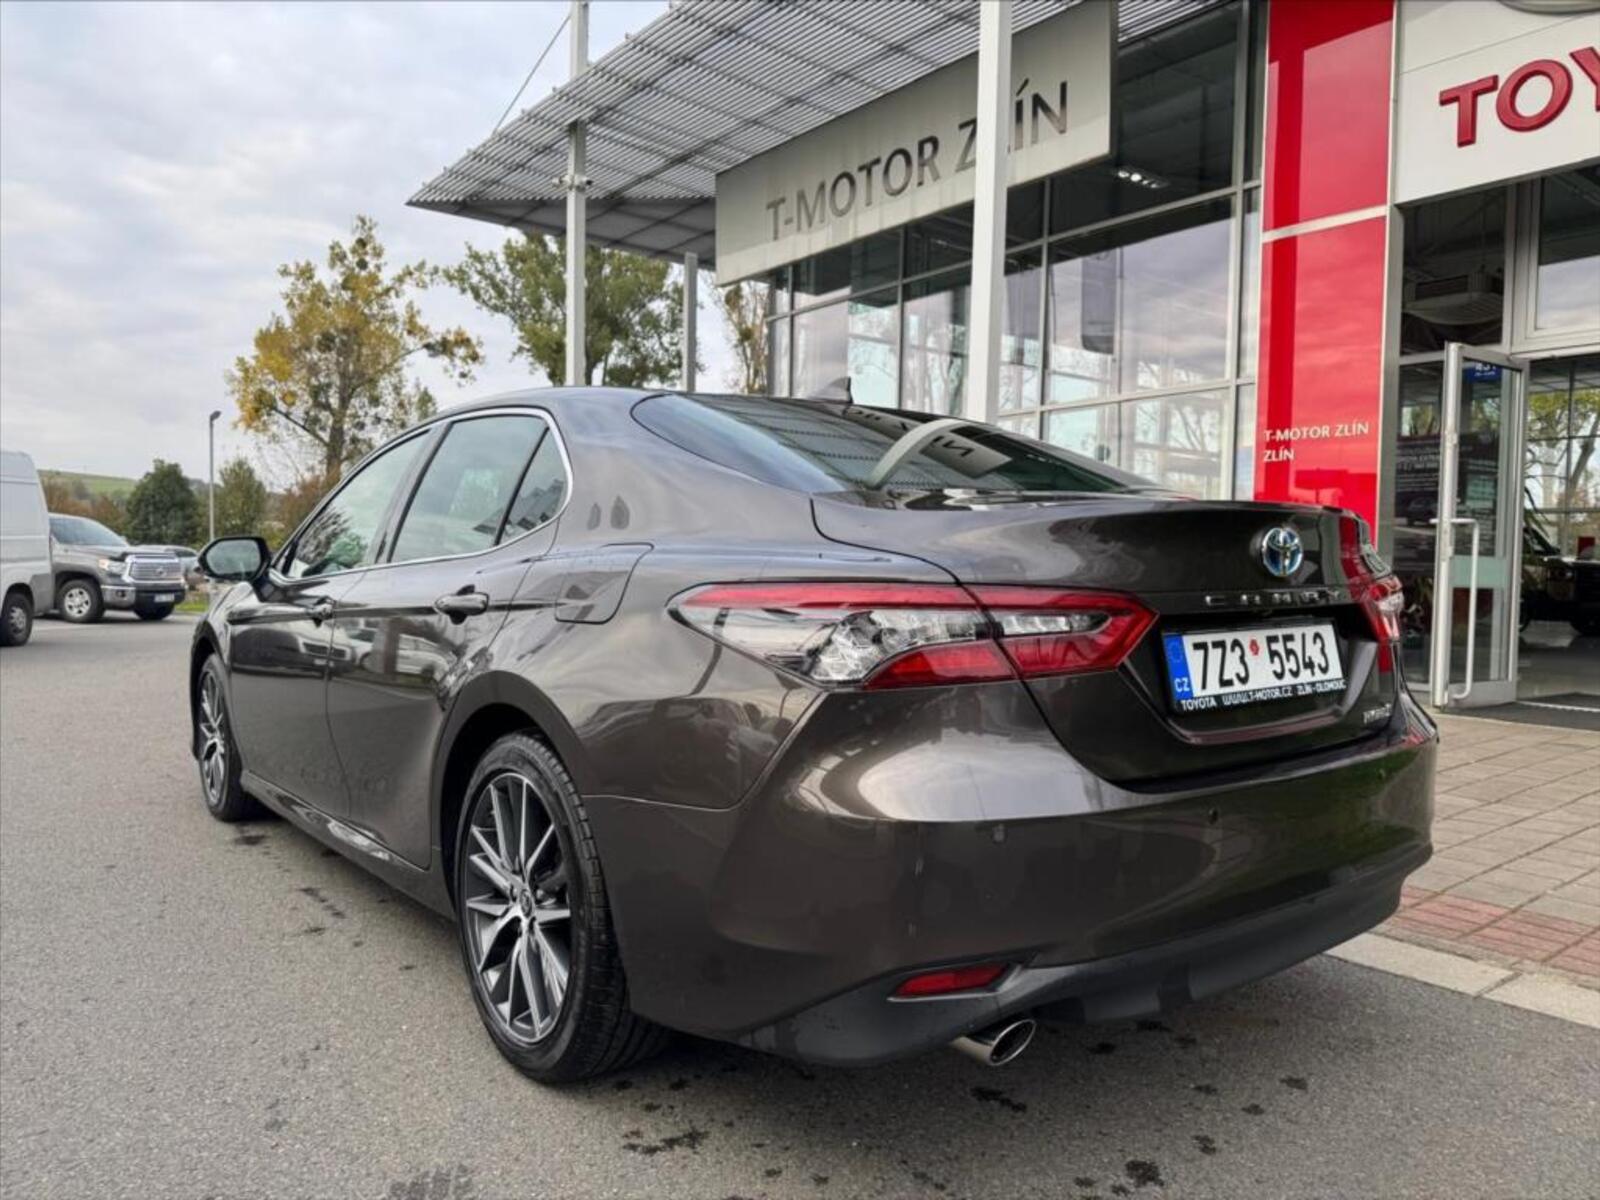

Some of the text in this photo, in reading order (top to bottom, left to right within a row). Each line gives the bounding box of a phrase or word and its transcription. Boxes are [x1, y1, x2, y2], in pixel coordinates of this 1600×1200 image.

[765, 78, 1068, 240] T-MOTOR ZÍN
[1263, 418, 1369, 442] T-MOTOR ZLÍN
[1263, 445, 1295, 462] ZLÍN
[1192, 631, 1330, 690] 7Z3 5543
[1174, 677, 1190, 693] CZ
[1181, 697, 1217, 711] TOYOTA
